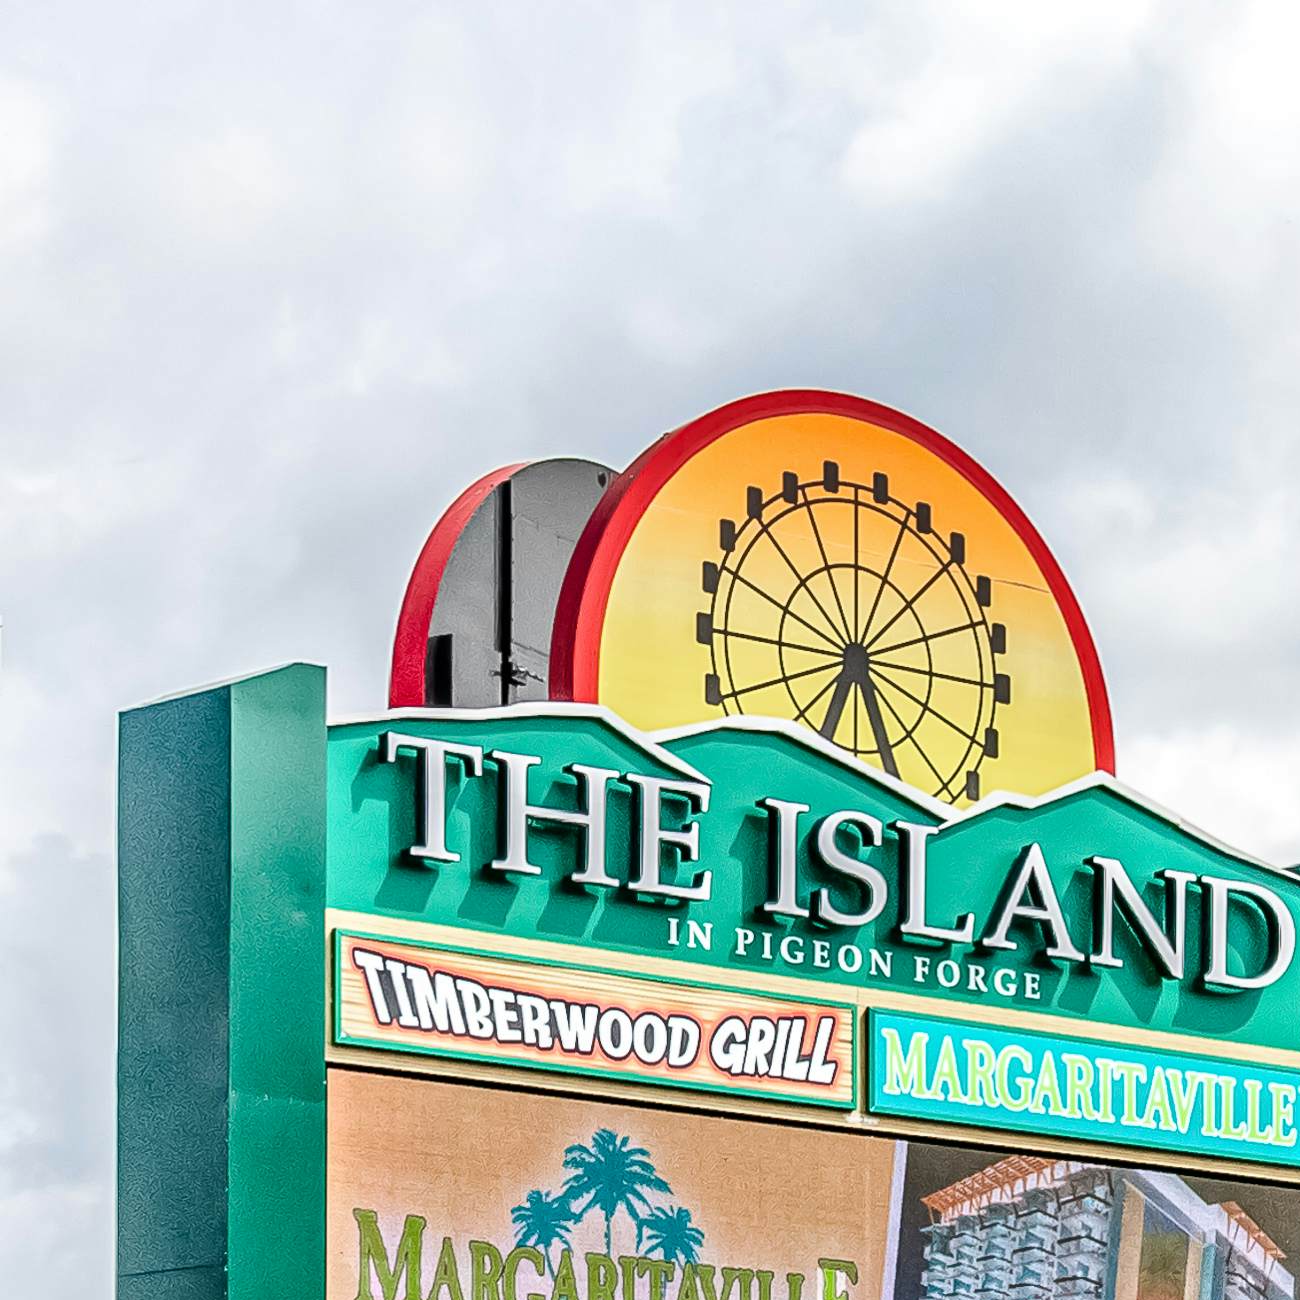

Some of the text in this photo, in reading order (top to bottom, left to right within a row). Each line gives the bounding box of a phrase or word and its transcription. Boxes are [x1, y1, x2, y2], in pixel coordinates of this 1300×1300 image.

[384, 731, 1298, 990] THE ISLAND
[352, 948, 838, 1086] TIMBERWOOD GRILL
[668, 917, 1041, 999] IN PIGEON FORGE
[881, 1028, 1298, 1146] MARGARITAVILLE
